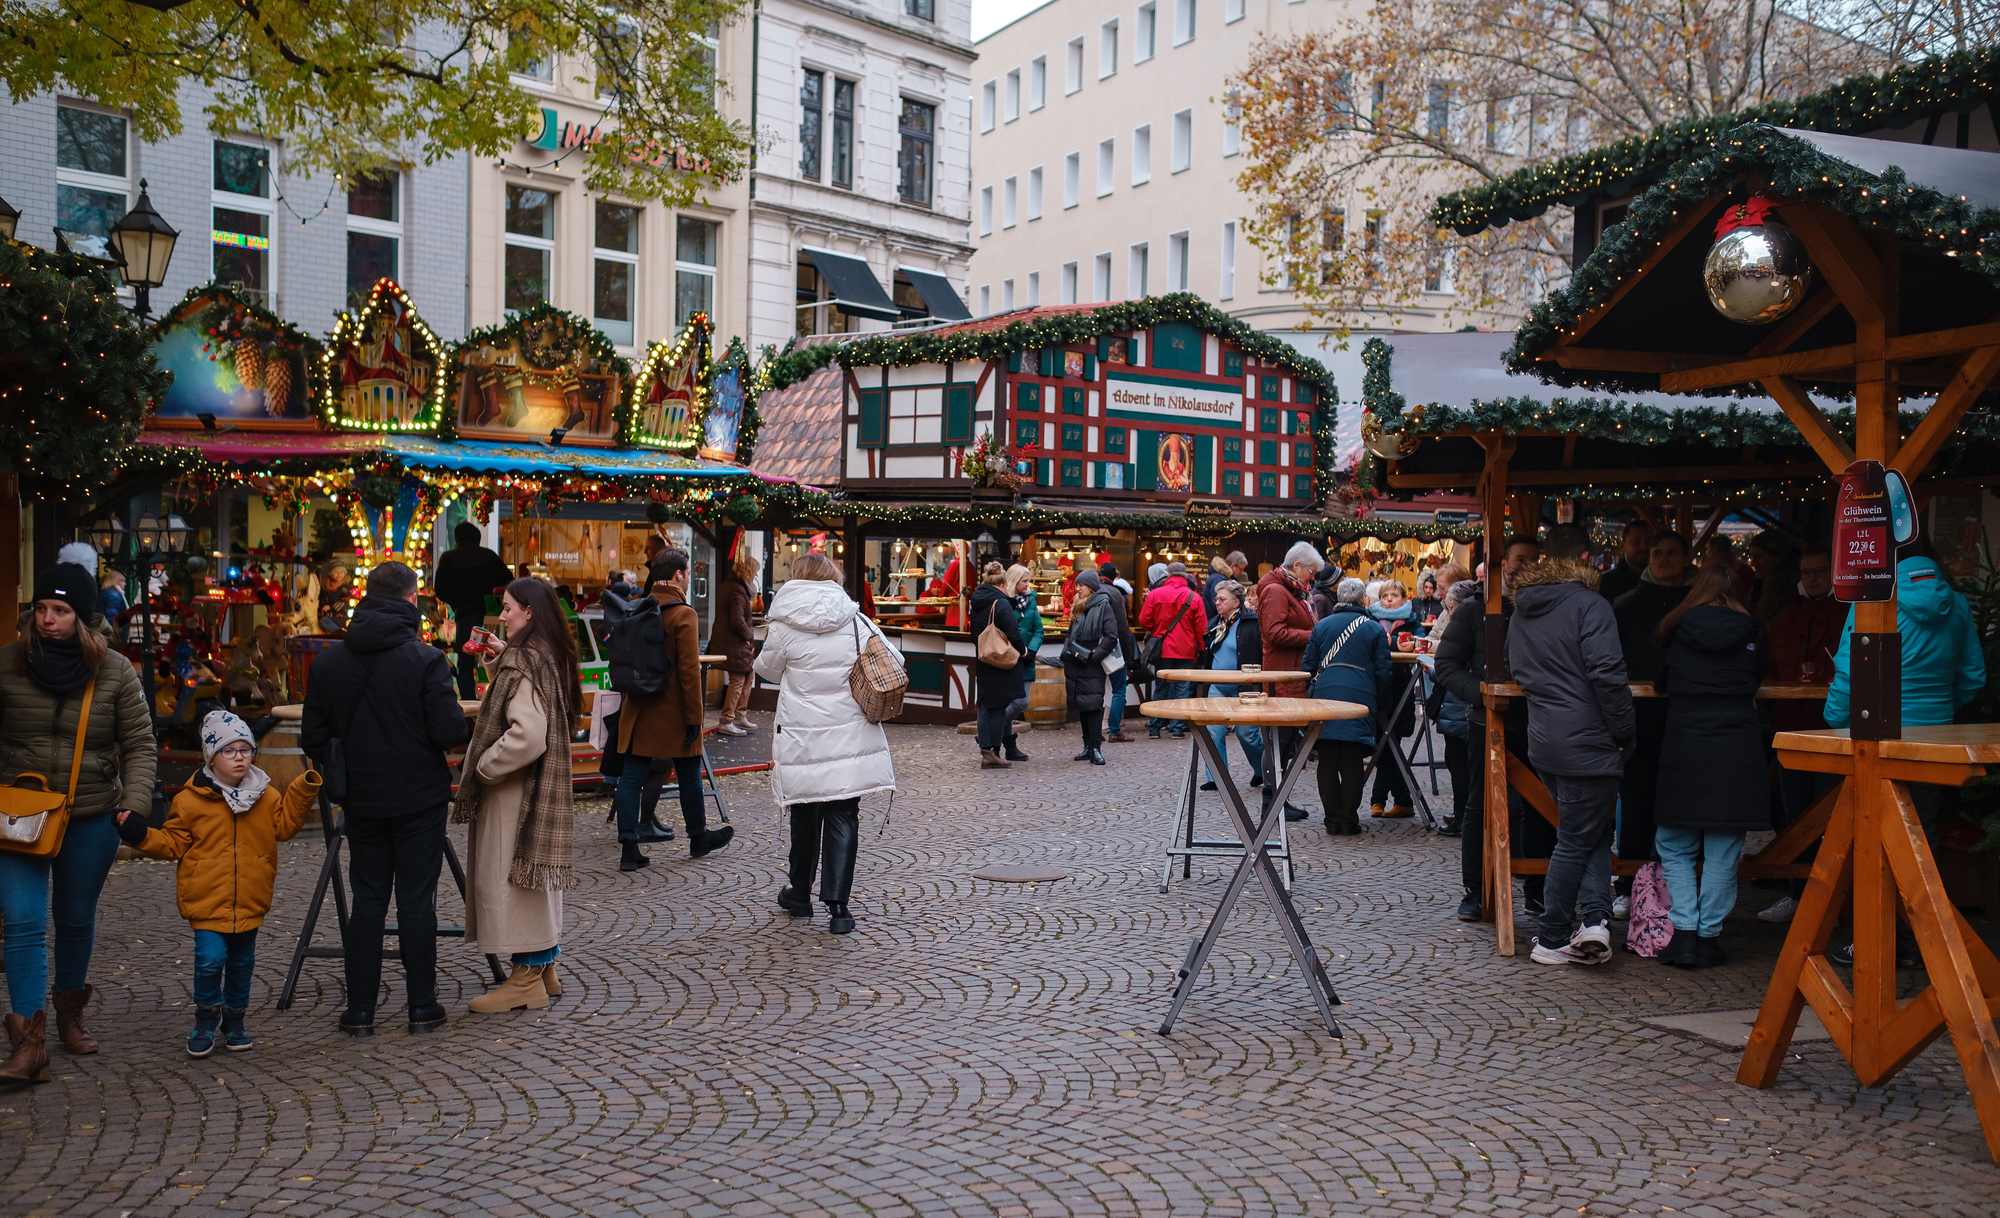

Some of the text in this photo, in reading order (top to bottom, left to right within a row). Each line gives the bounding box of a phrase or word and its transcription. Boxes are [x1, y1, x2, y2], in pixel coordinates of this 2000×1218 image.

[1171, 338, 1185, 349] 24
[1029, 389, 1037, 400] 8
[1074, 391, 1081, 402] 9
[1112, 389, 1234, 416] Advent im Nikolausdorf
[1021, 428, 1036, 438] 13
[1066, 430, 1080, 440] 17
[1110, 435, 1123, 444] 12
[1225, 441, 1239, 450] 20
[1066, 467, 1080, 477] 15
[1227, 475, 1239, 485] 22
[1843, 505, 1882, 516] Glühwein
[1849, 540, 1876, 555] 22,50 €
[545, 552, 558, 560] dean
